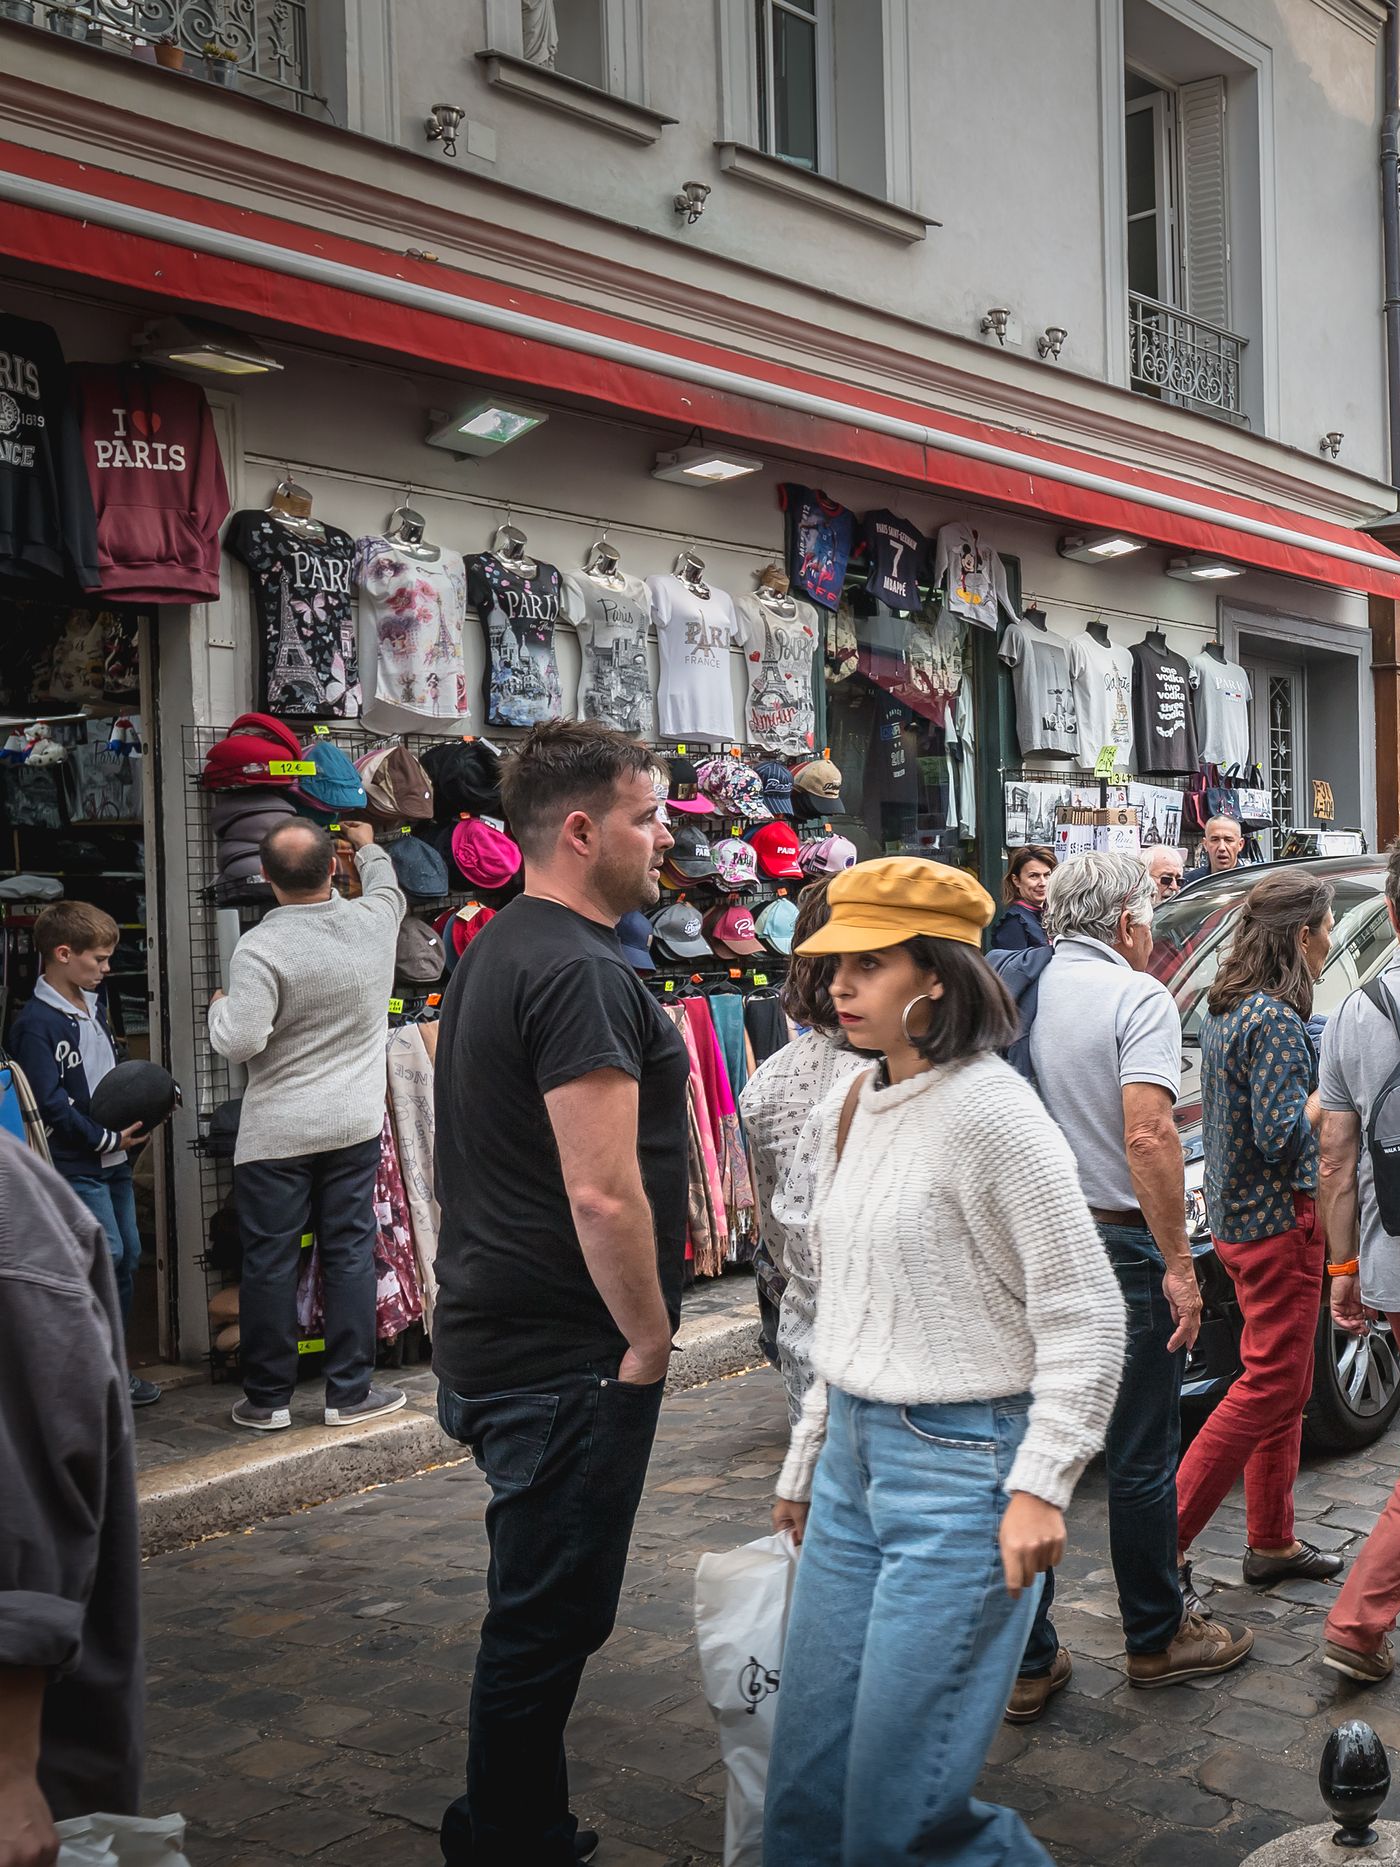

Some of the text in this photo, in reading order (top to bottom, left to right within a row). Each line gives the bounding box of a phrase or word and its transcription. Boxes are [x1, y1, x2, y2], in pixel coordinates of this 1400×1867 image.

[0, 351, 41, 400] RIS
[112, 408, 127, 437] I
[94, 440, 187, 472] PARIS
[889, 539, 904, 578] 7
[883, 575, 907, 597] MBAPPÉ
[597, 597, 634, 625] Paris
[684, 655, 721, 669] FRANCE
[1160, 665, 1178, 675] one
[1156, 673, 1185, 684] vodka
[1163, 682, 1181, 692] two
[1156, 691, 1186, 701] vodka
[1159, 702, 1184, 713] three
[750, 706, 798, 731] Amour
[1157, 711, 1185, 721] vodka
[281, 763, 293, 774] 12
[55, 1039, 84, 1079] Pa
[1383, 1146, 1397, 1154] WALK
